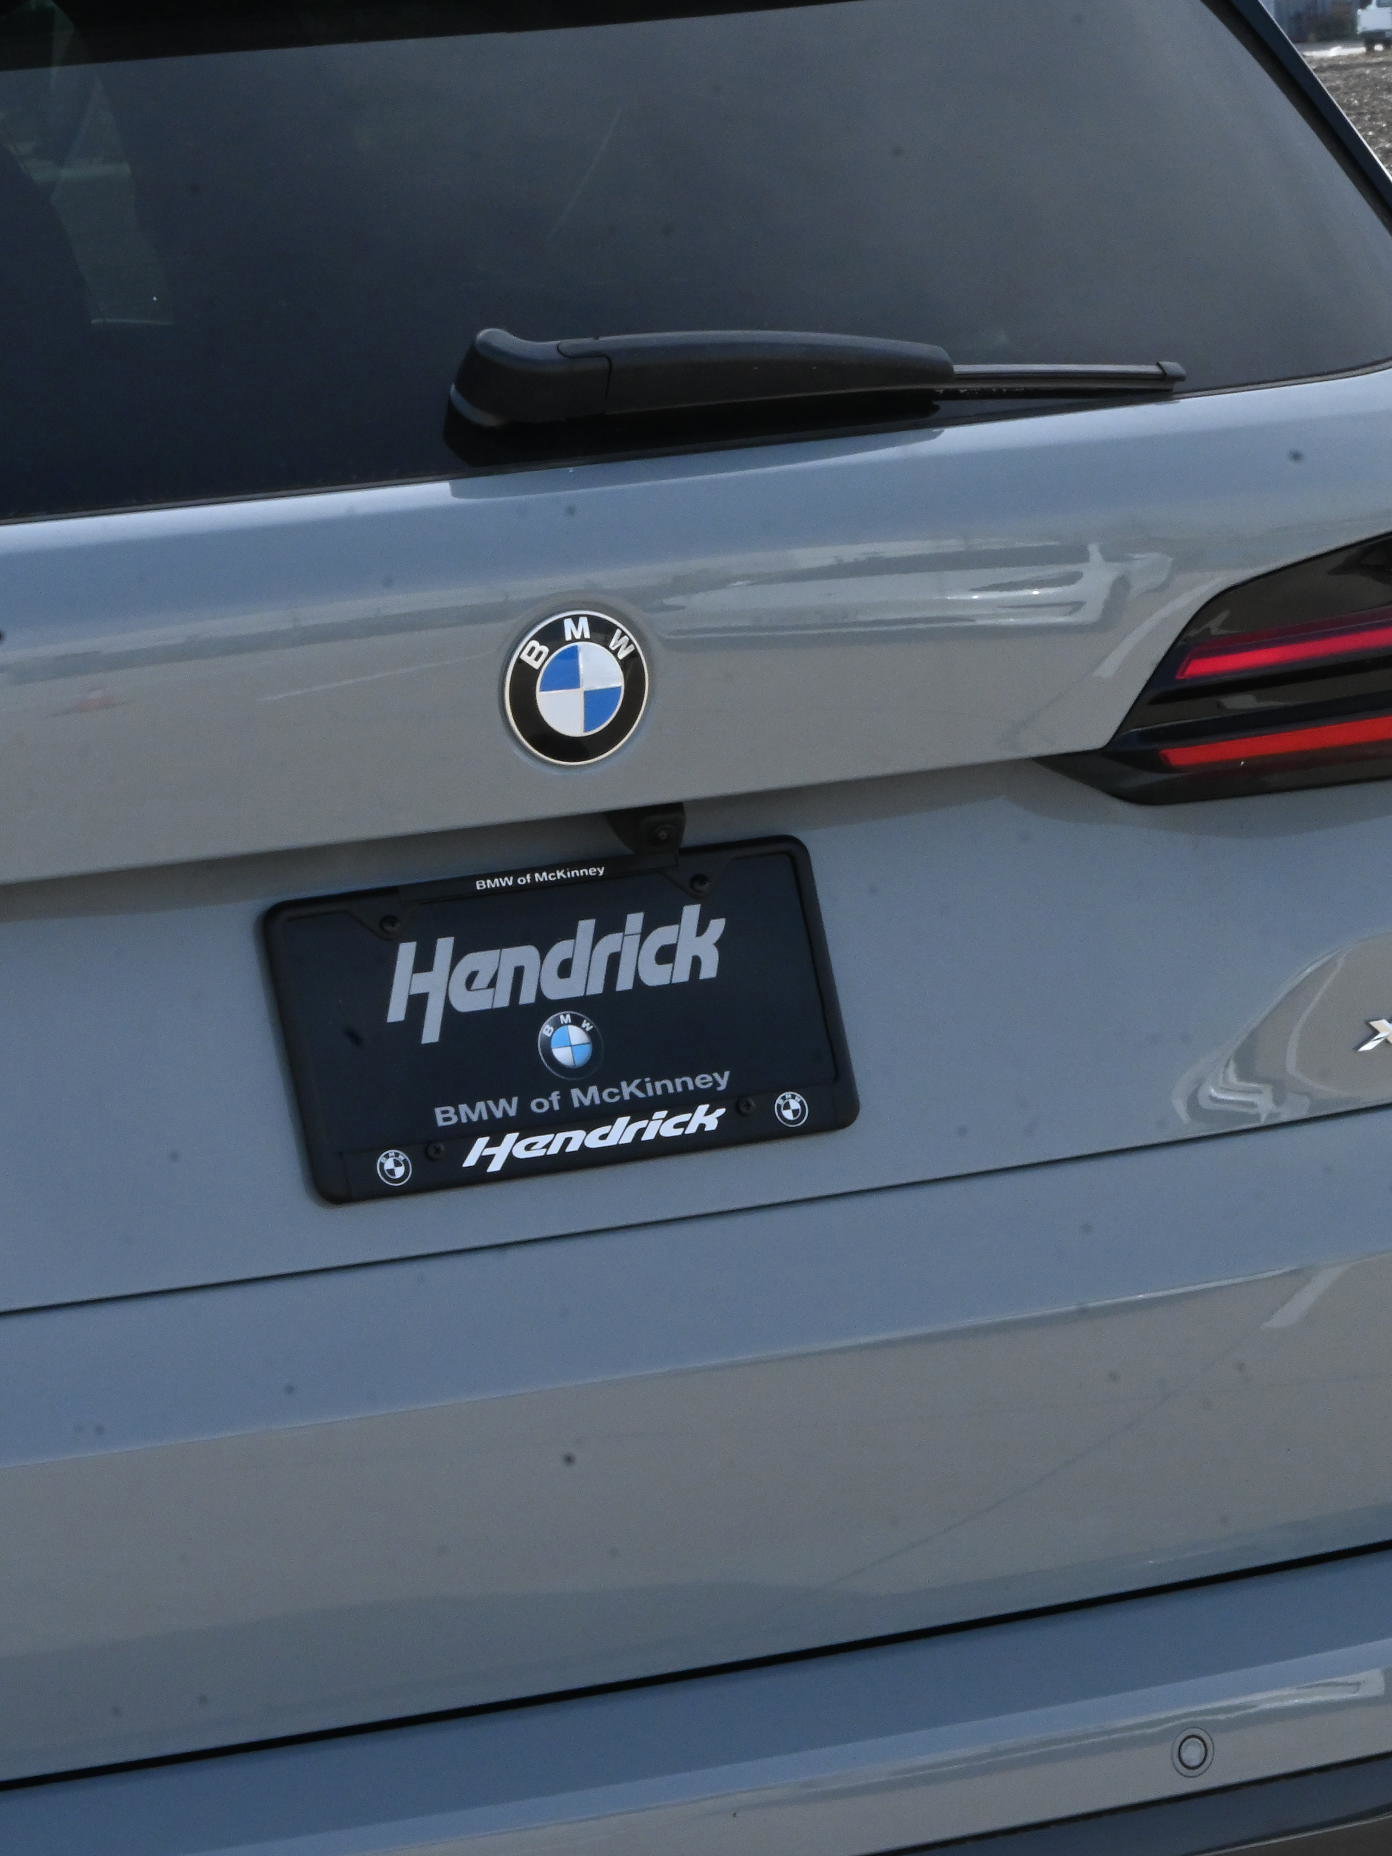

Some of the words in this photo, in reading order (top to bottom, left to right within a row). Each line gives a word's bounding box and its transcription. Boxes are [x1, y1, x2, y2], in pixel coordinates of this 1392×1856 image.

[520, 616, 635, 670] BMW
[476, 876, 513, 890] BMW
[517, 873, 532, 885] of
[534, 866, 605, 883] McKinney
[386, 904, 726, 1044] Hendrick
[542, 1013, 594, 1037] BMW
[434, 1097, 519, 1127] BMW
[530, 1091, 562, 1114] of
[571, 1070, 731, 1108] McKinney
[462, 1104, 727, 1172] Hendrick
